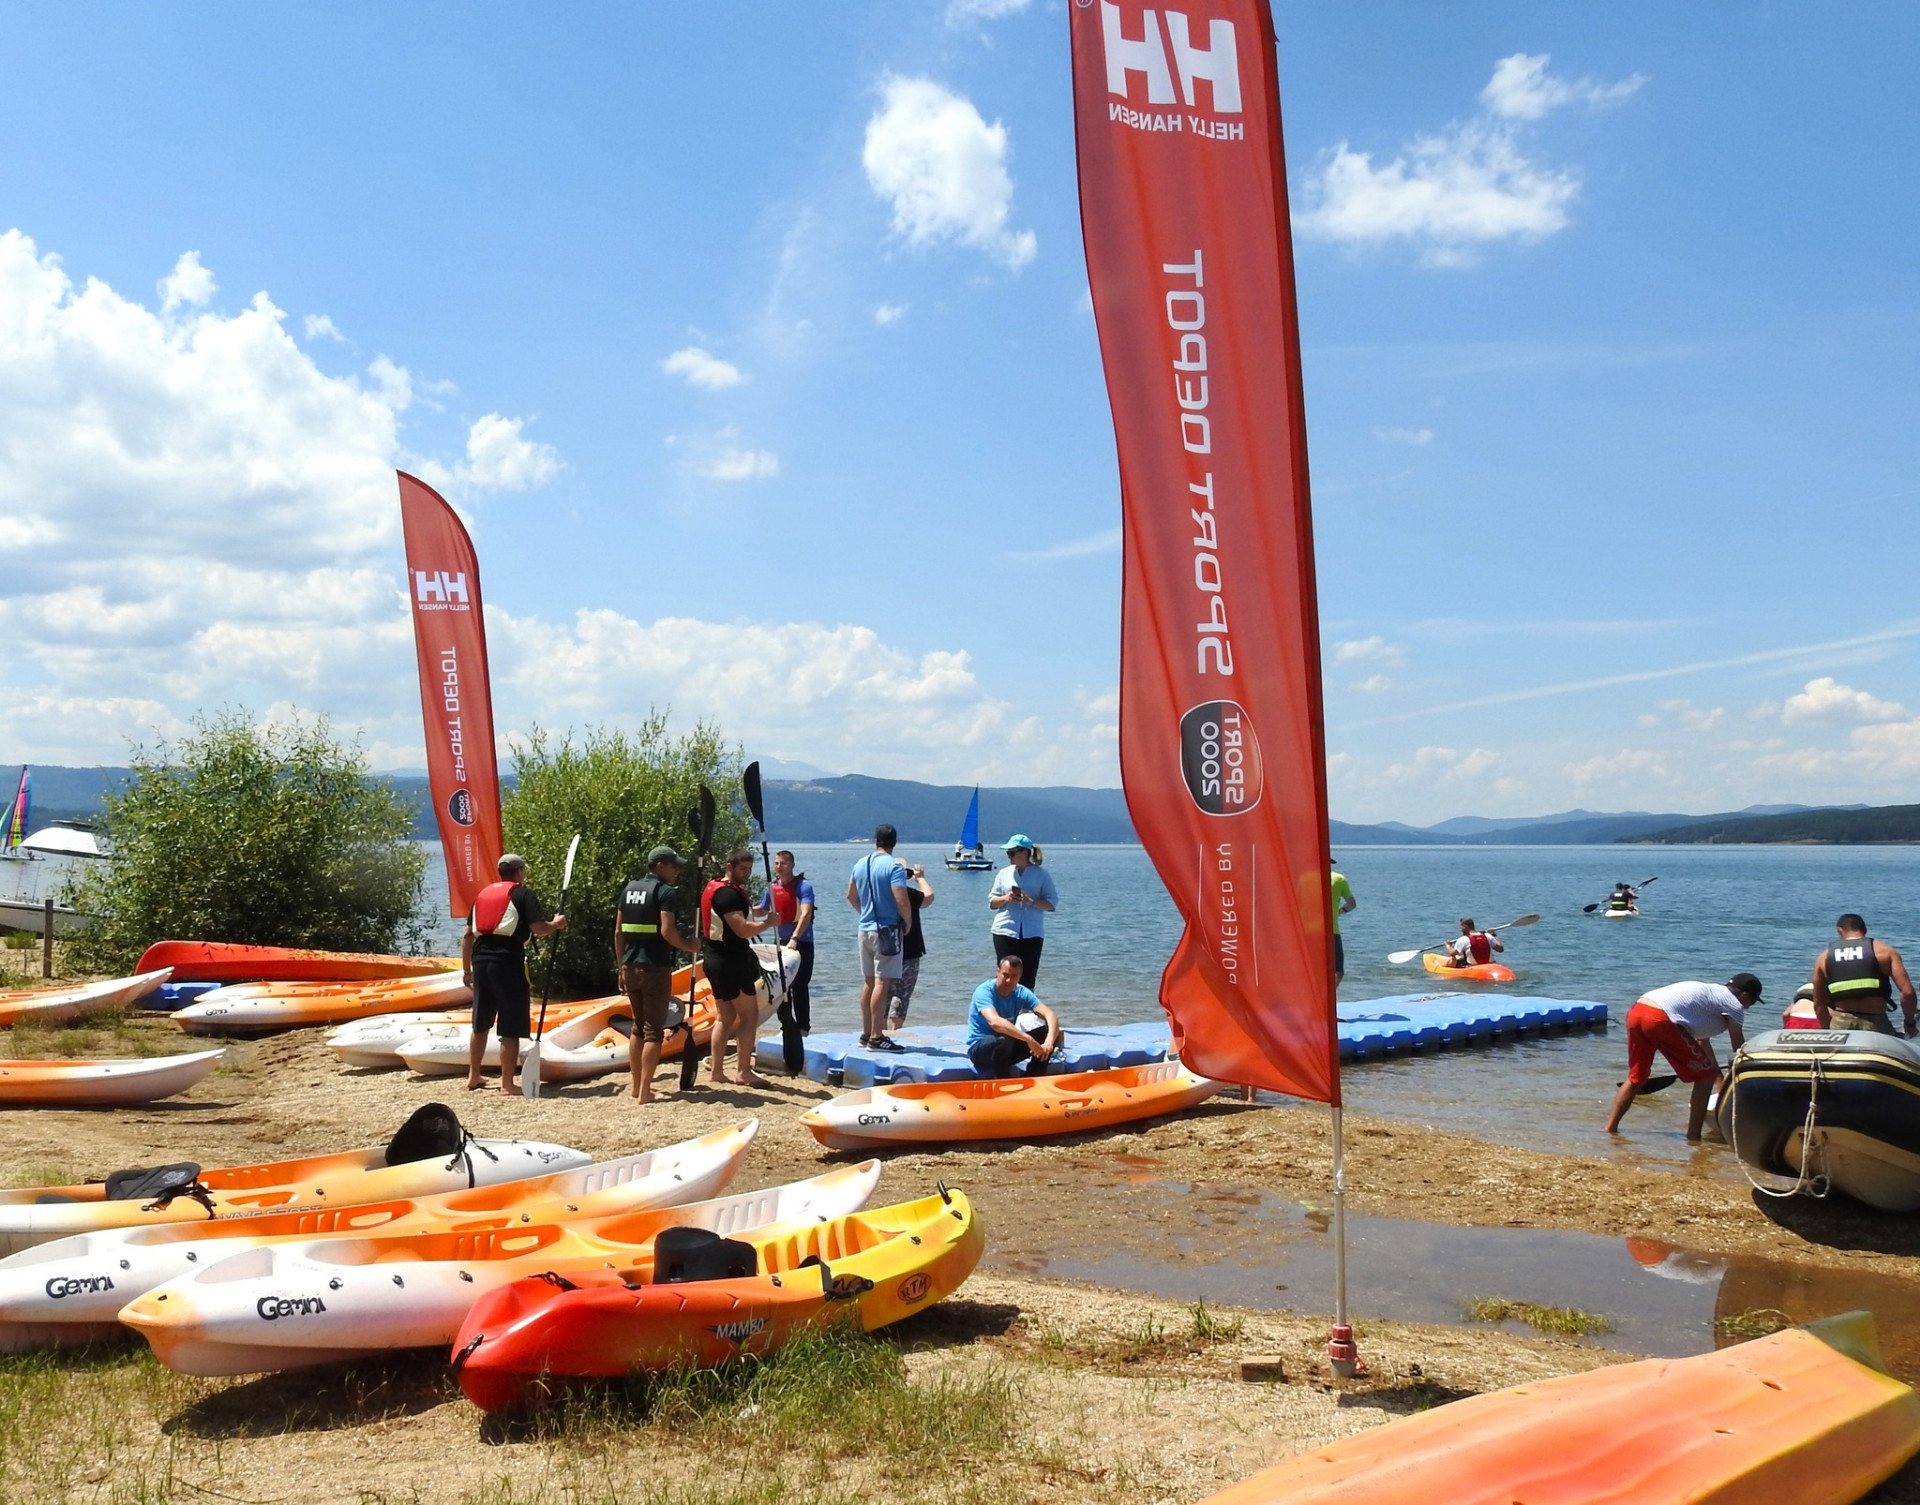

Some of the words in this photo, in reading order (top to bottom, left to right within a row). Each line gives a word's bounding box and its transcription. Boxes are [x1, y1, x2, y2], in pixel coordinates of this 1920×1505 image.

[626, 890, 647, 904] HH
[1834, 946, 1864, 962] HH
[45, 1272, 115, 1299] Gemini
[257, 1293, 327, 1321] Gemini
[716, 1318, 764, 1340] MAMBO
